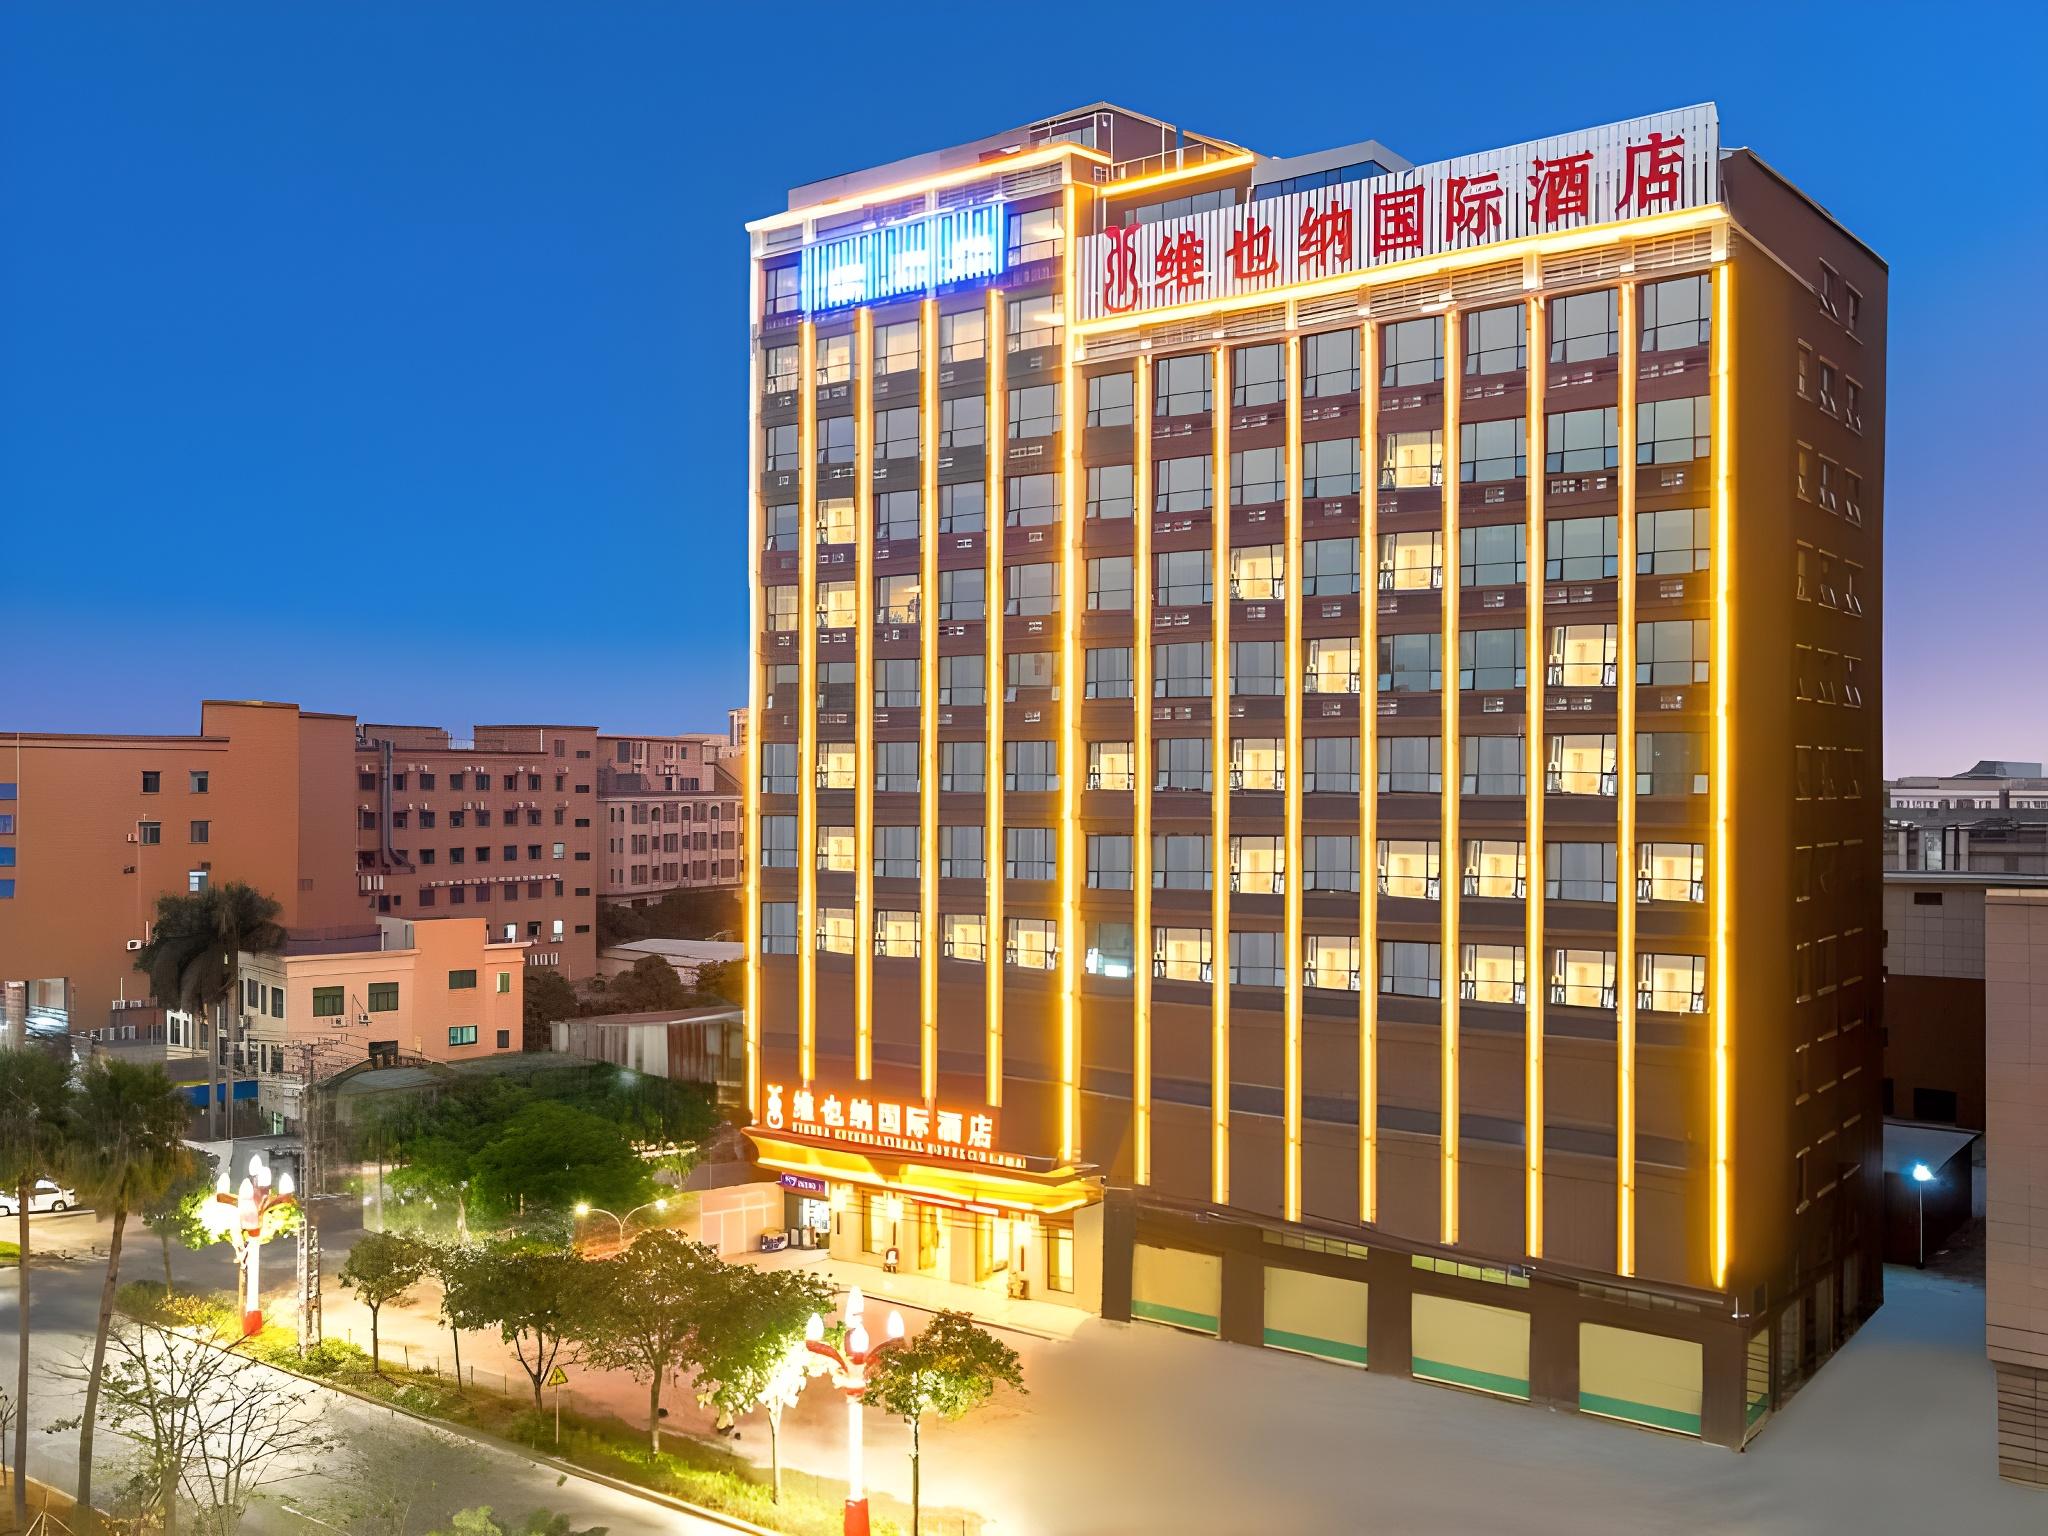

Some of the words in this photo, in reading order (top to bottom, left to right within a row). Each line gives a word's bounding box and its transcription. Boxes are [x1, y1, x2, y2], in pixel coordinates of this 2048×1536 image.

[1156, 133, 1685, 291] 维也纳国际酒店
[793, 1090, 993, 1149] 维也纳国际酒店
